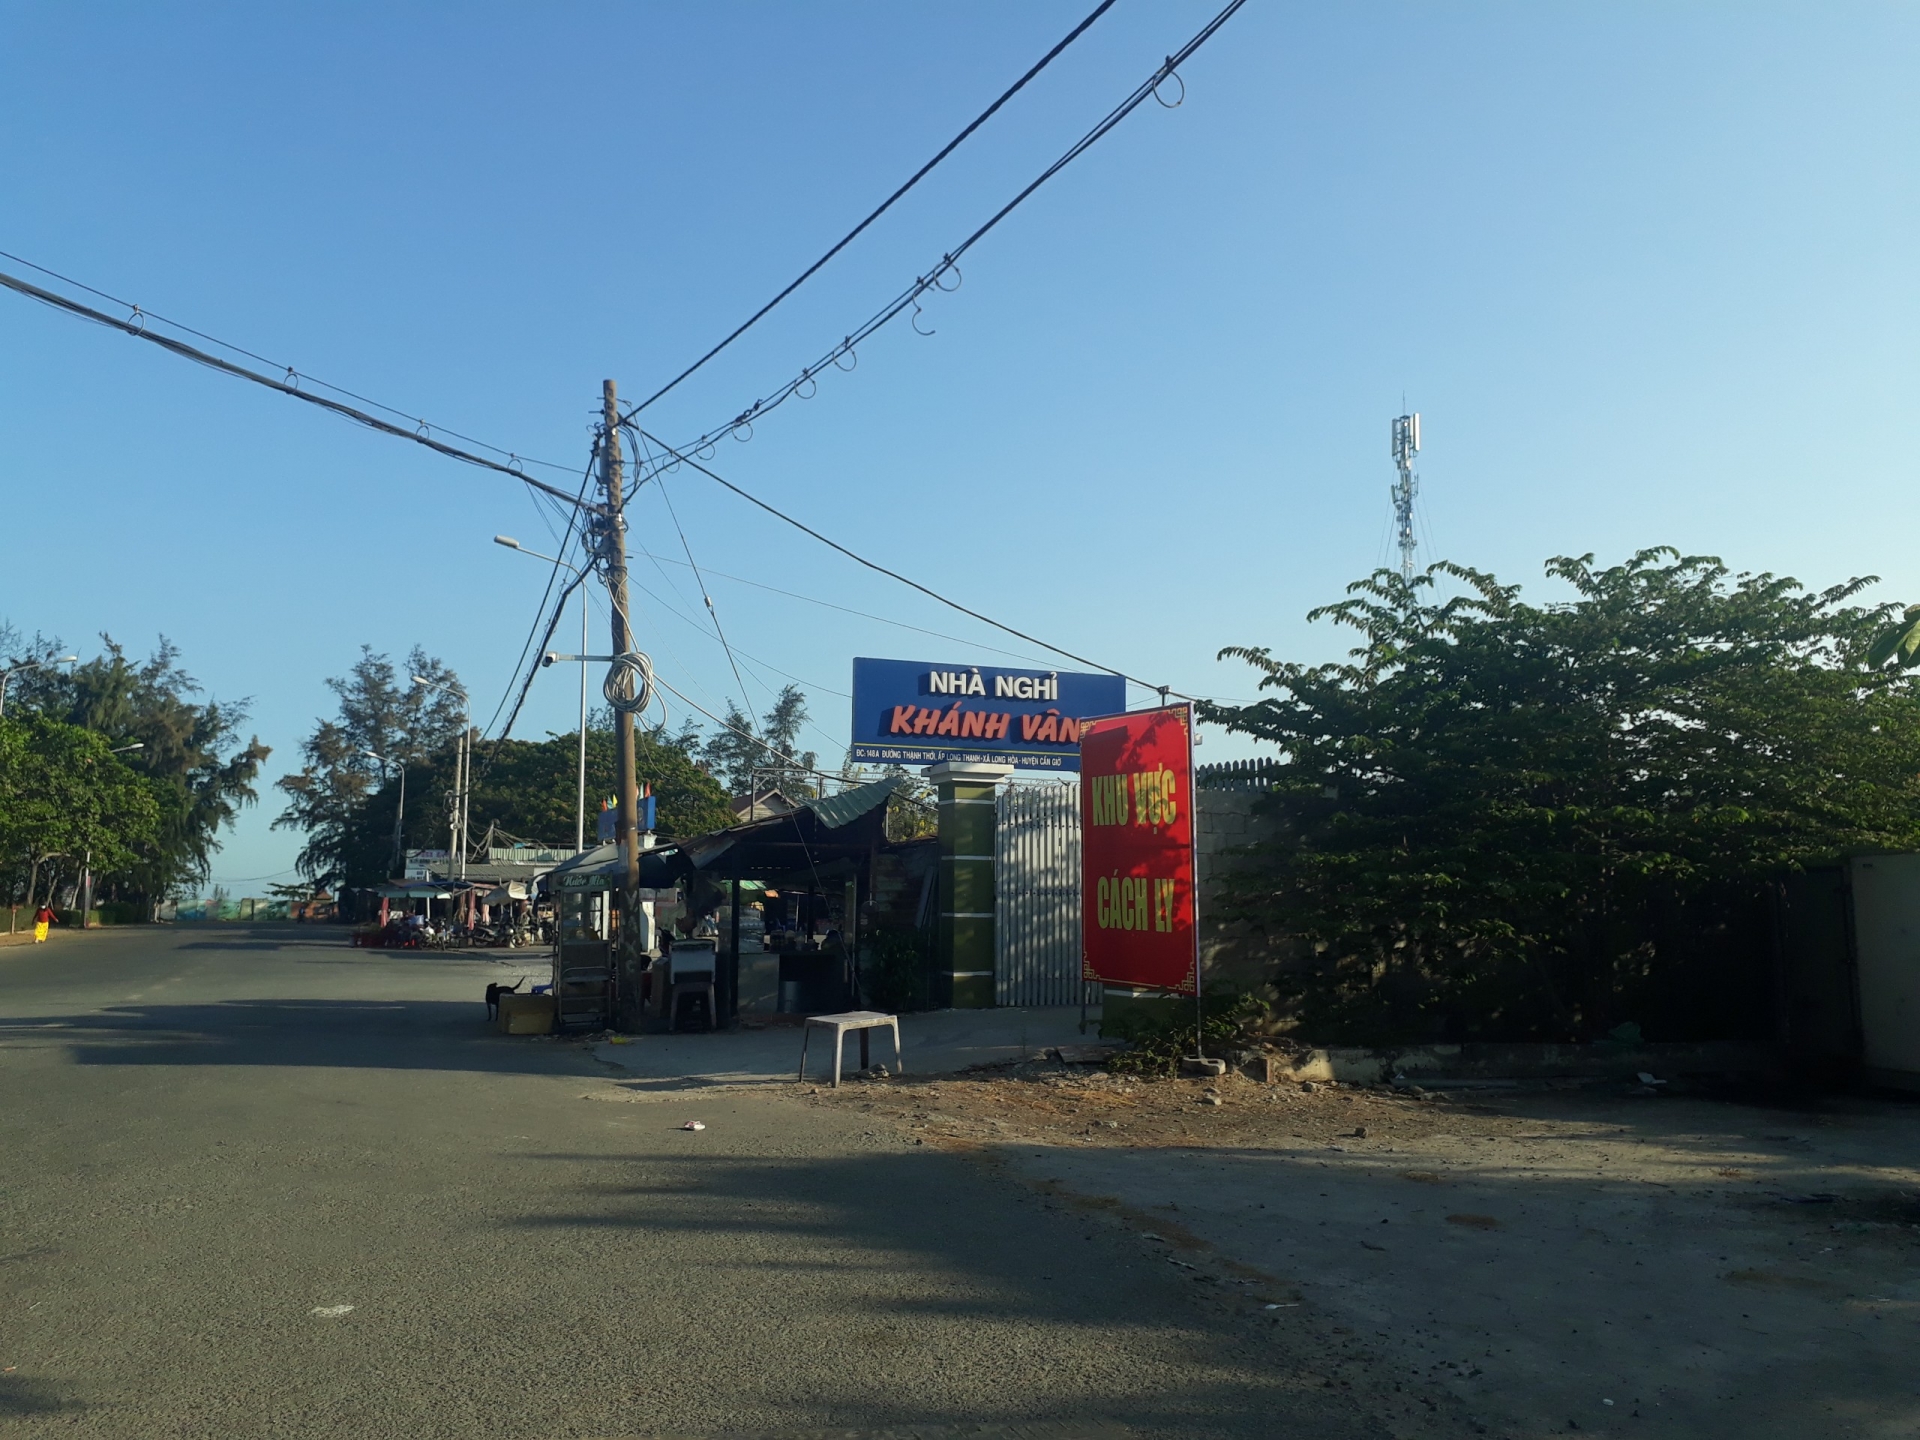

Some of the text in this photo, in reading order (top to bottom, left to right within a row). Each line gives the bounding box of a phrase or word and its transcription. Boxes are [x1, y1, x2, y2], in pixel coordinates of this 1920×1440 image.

[930, 667, 1058, 700] NHÀ NGHỈ
[890, 700, 1080, 743] KHÁNH VÂN
[946, 753, 962, 762] LONG
[991, 754, 1006, 764] LONG
[1092, 762, 1176, 835] KHU VỰC
[1097, 869, 1175, 933] CÁCH LY
